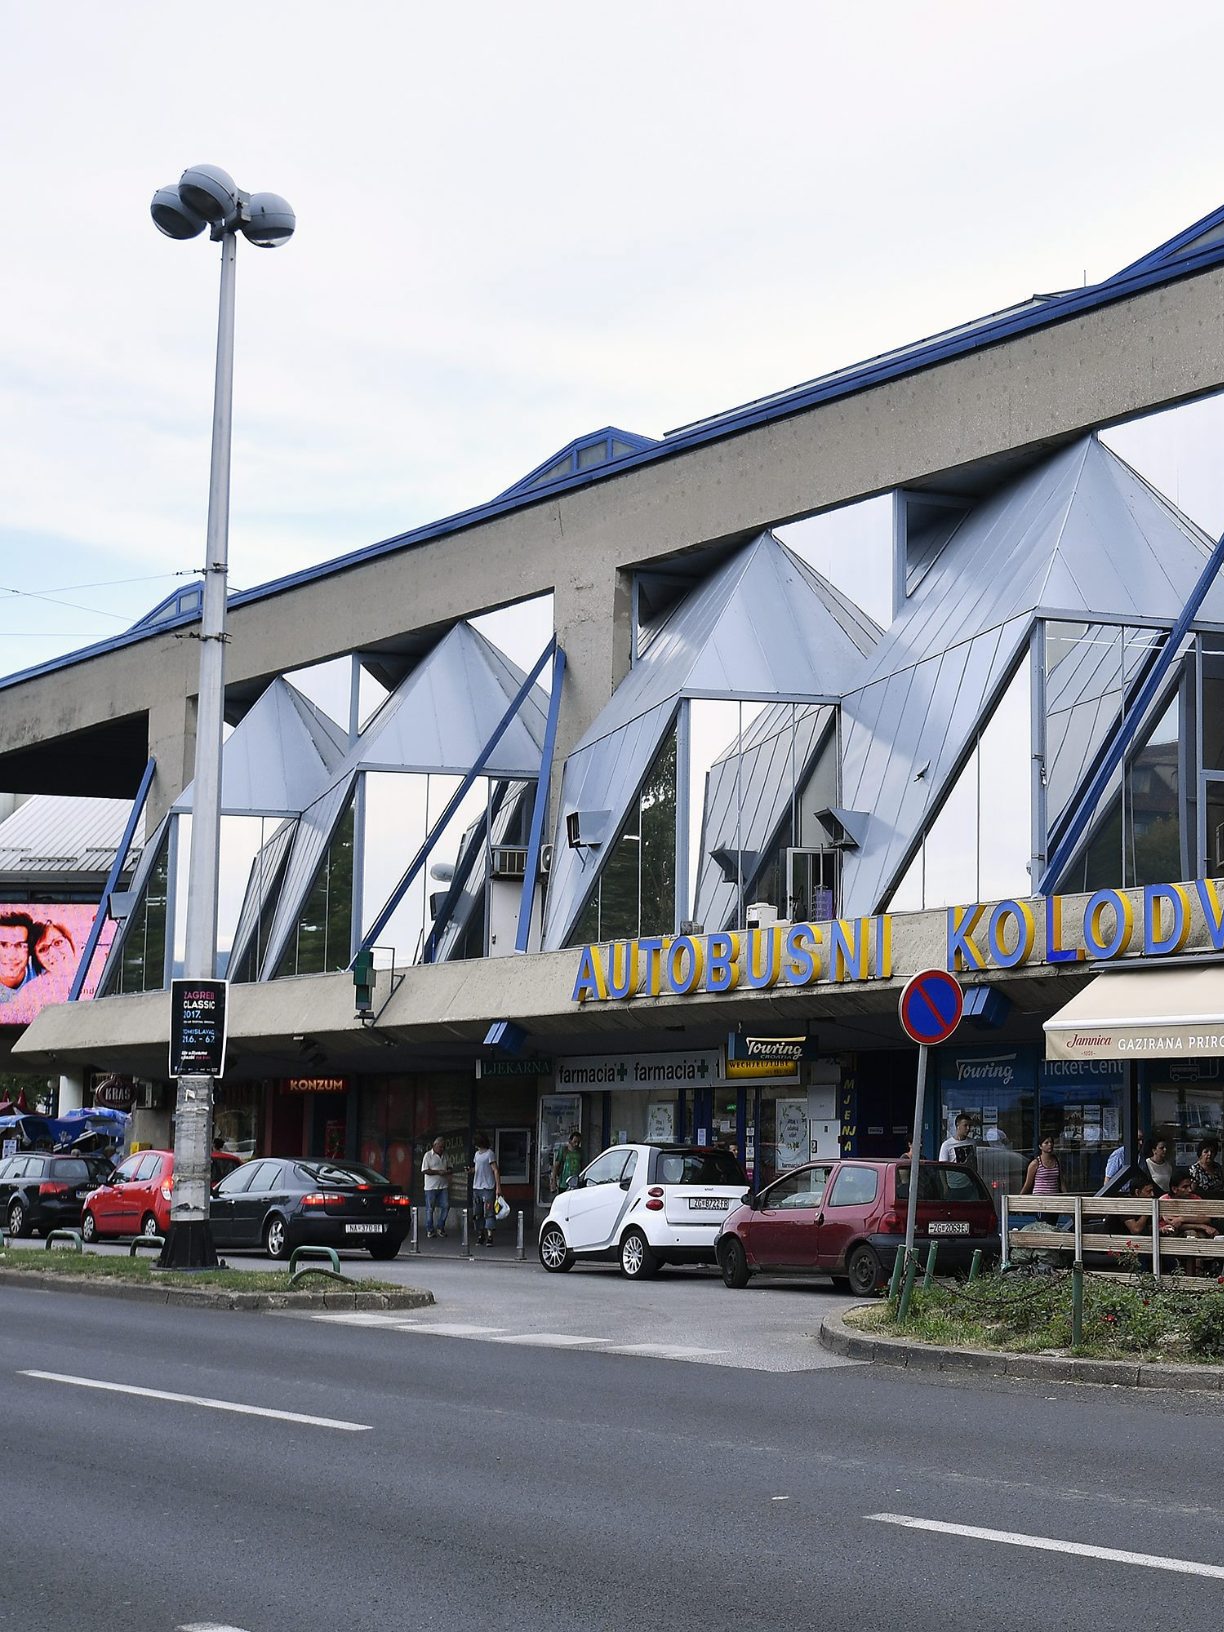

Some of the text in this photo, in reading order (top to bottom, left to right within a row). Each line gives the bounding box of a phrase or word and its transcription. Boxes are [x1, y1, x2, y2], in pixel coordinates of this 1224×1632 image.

[571, 915, 892, 1001] AUTOBUSNI
[183, 991, 215, 1000] ZAGREB
[183, 1000, 216, 1009] CLASSIC
[746, 1036, 807, 1060] Touring
[1066, 1034, 1112, 1048] Jamnica
[1118, 1037, 1183, 1050] GAZIRANA
[483, 1061, 550, 1076] LJEKARNA
[559, 1063, 616, 1083] farmacia
[634, 1060, 696, 1081] farmacia
[955, 1053, 1017, 1085] Touring
[289, 1078, 344, 1091] KONZUM
